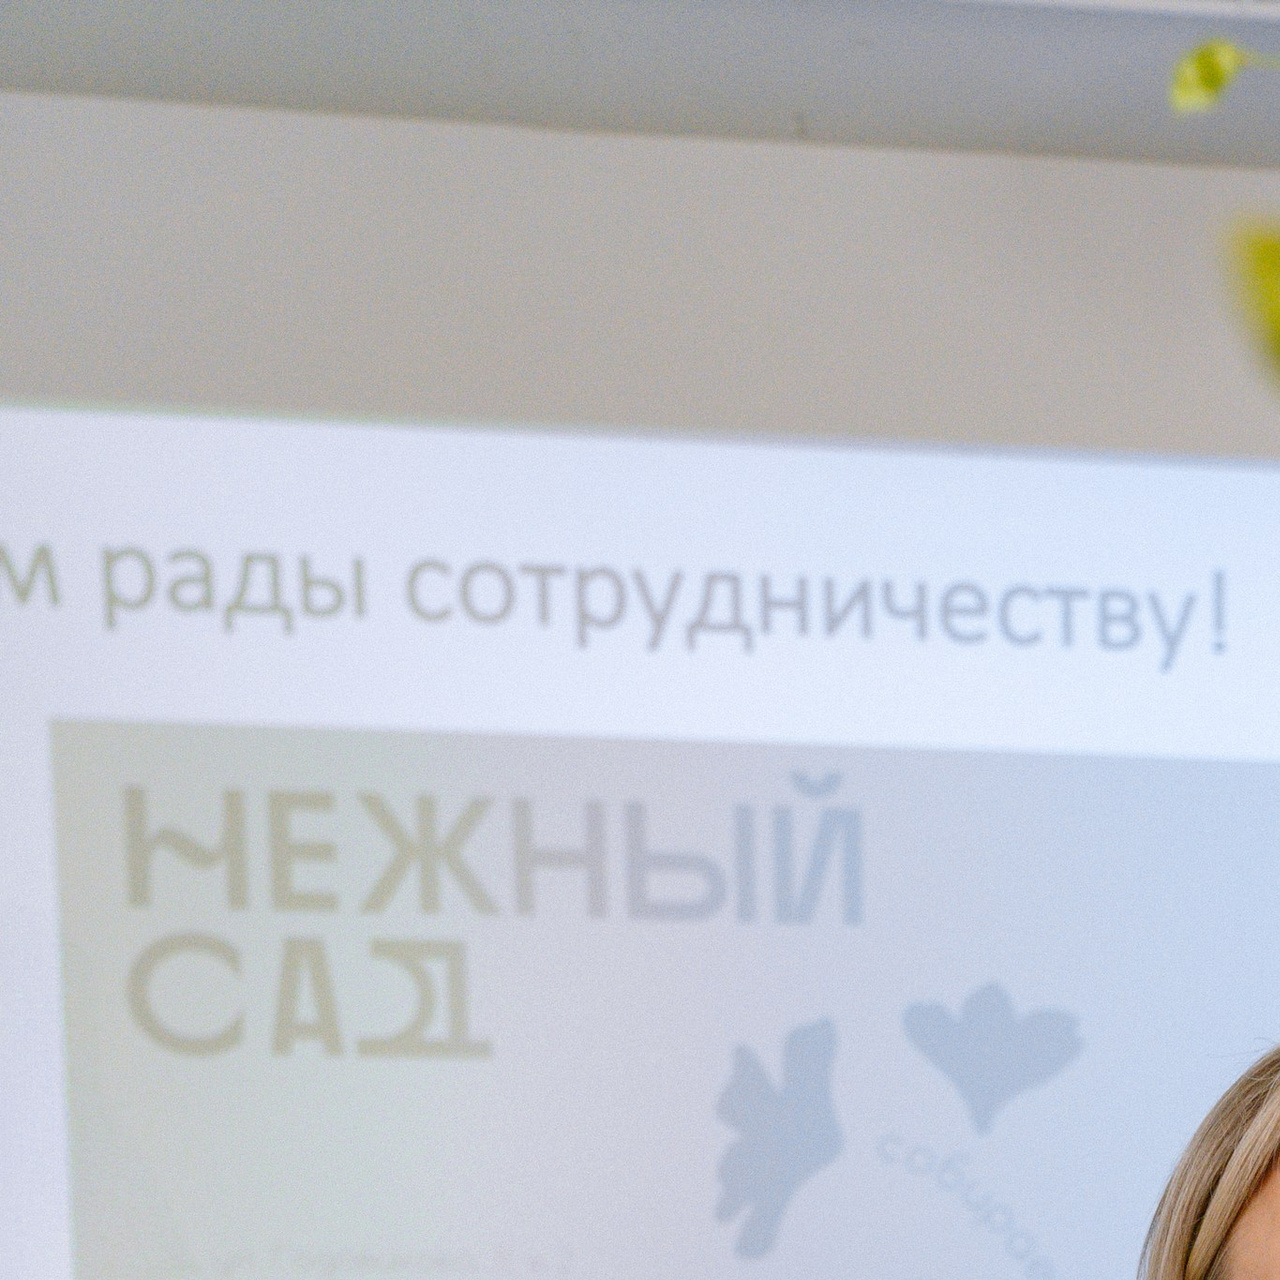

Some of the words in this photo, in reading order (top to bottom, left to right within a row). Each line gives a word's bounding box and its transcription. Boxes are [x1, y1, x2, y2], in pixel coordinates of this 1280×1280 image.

[102, 545, 366, 634] рады
[406, 557, 1229, 675] сотрудничеству!
[121, 769, 864, 927] НЕЖНЫЙ
[125, 932, 494, 1060] САД
